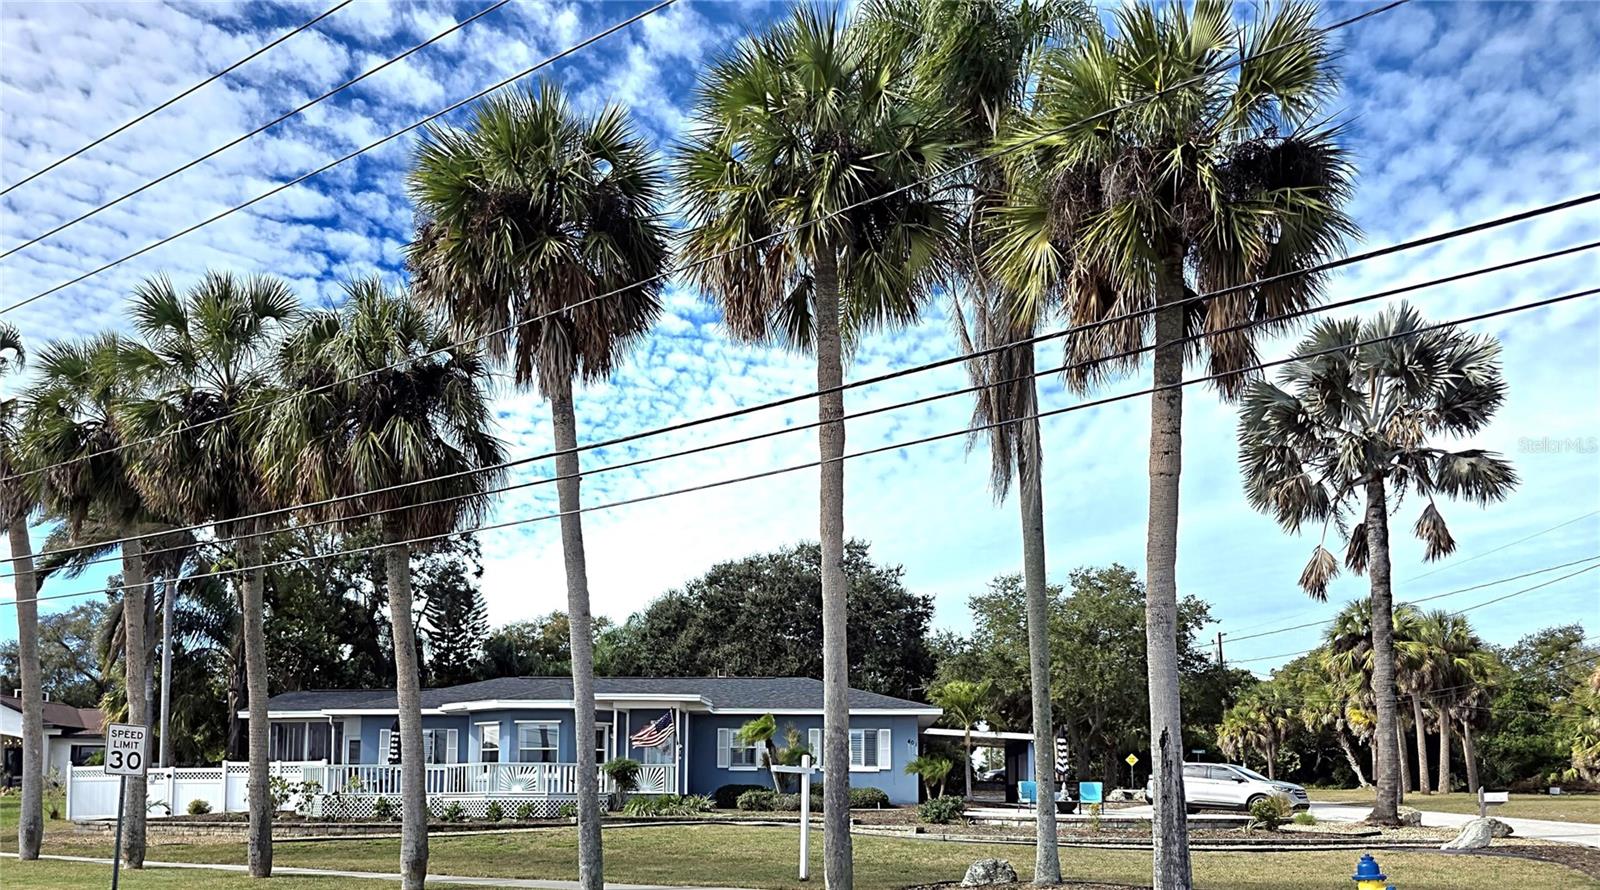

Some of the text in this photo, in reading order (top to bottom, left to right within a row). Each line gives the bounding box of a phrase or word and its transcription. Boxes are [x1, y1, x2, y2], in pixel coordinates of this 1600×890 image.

[111, 729, 144, 739] SPEED
[113, 740, 139, 749] LIMIT
[109, 750, 142, 770] 30
